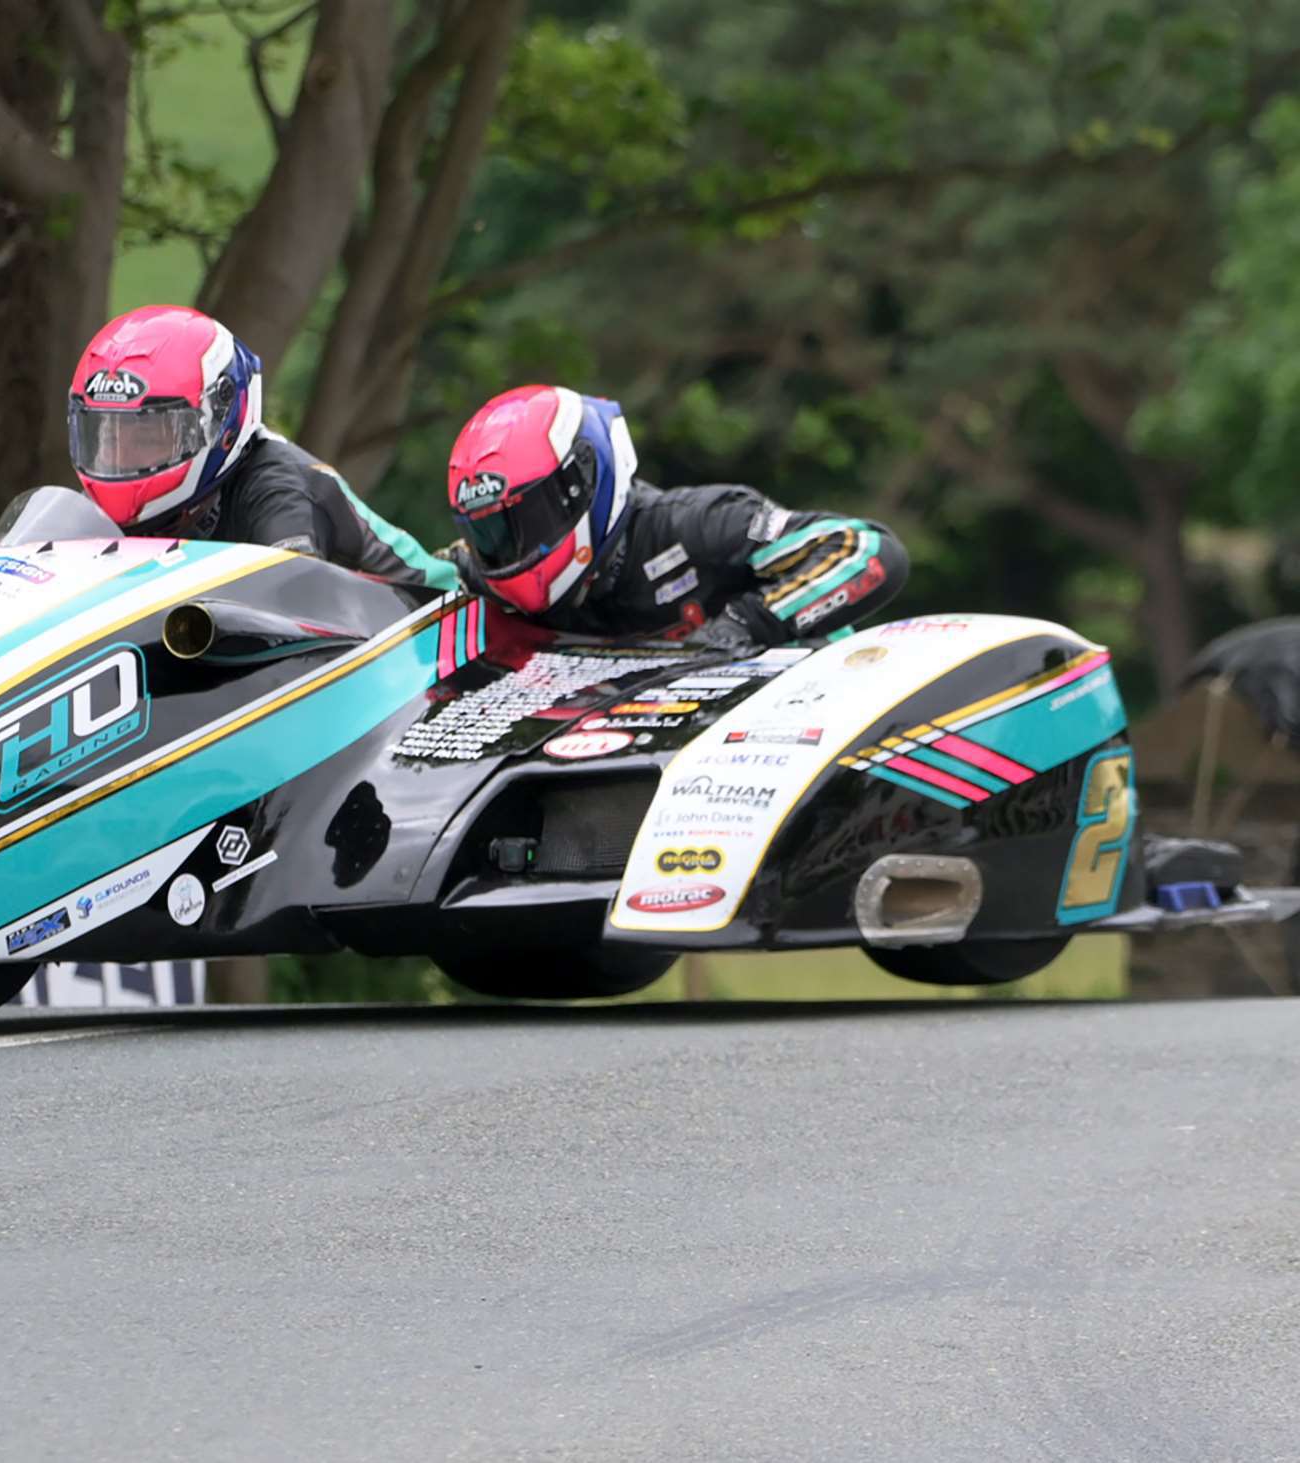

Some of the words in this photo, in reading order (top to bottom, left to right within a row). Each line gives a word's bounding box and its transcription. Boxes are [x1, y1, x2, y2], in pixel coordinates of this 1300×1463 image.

[86, 371, 139, 395] Airoh
[458, 475, 502, 502] Airoh
[12, 719, 132, 793] RACING
[672, 783, 777, 799] WALTHAM
[706, 797, 770, 809] SERVICES
[676, 811, 709, 823] John
[712, 811, 754, 823] Darke
[1060, 752, 1134, 914] 2
[640, 887, 714, 906] motrac
